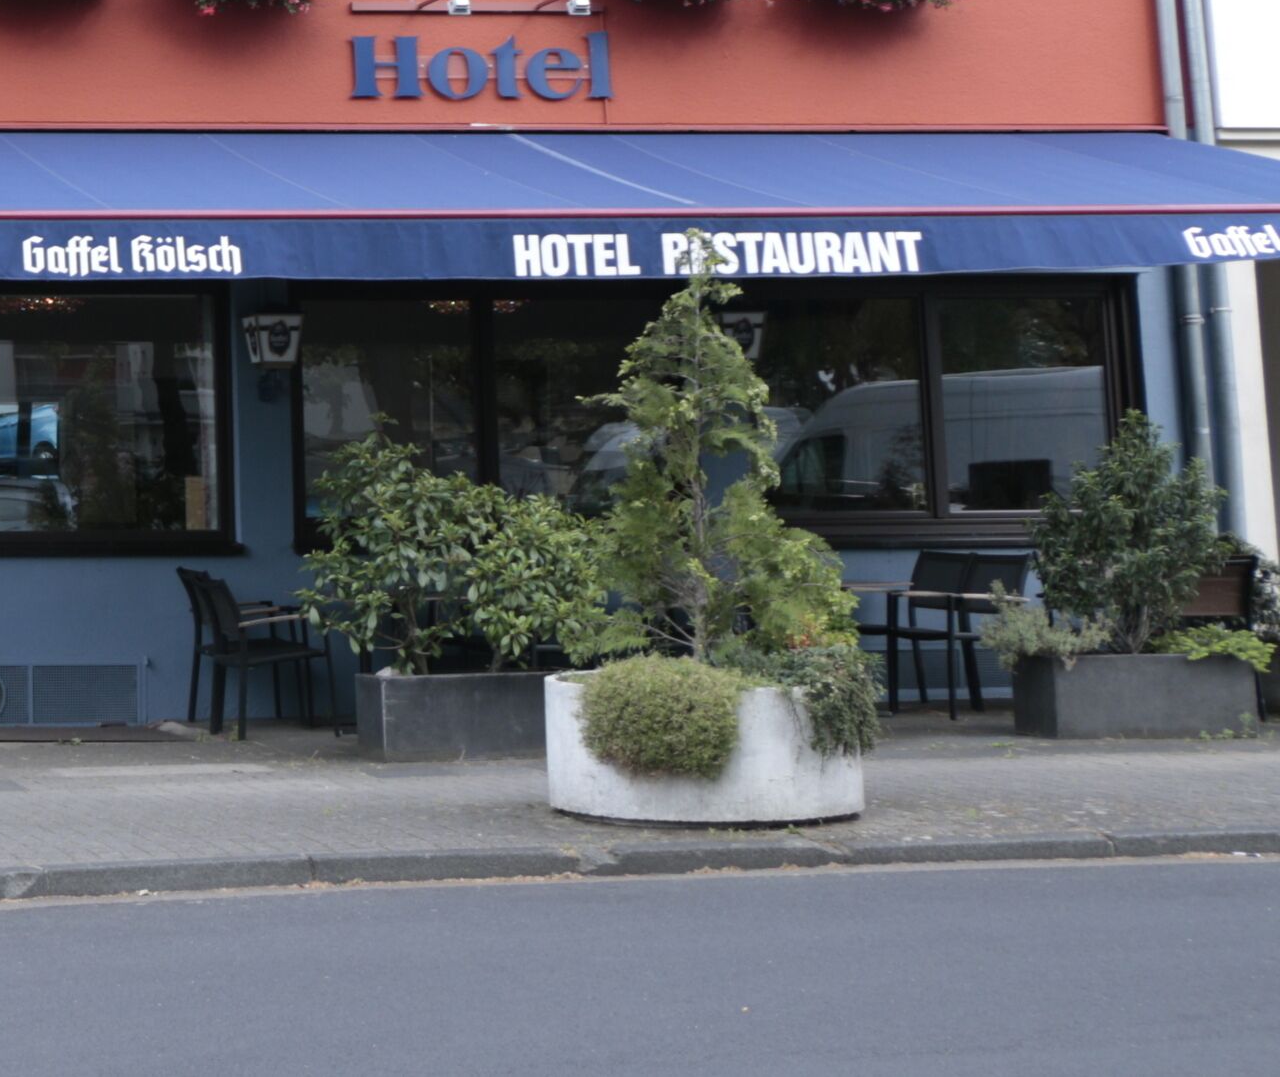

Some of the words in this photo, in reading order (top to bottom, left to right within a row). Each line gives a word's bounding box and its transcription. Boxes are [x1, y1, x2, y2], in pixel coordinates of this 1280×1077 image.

[349, 30, 615, 101] Hotel
[22, 235, 124, 277] Gaffel
[130, 235, 243, 276] Kölsch
[512, 234, 641, 277] HOTEL
[1182, 224, 1280, 259] Gaffel
